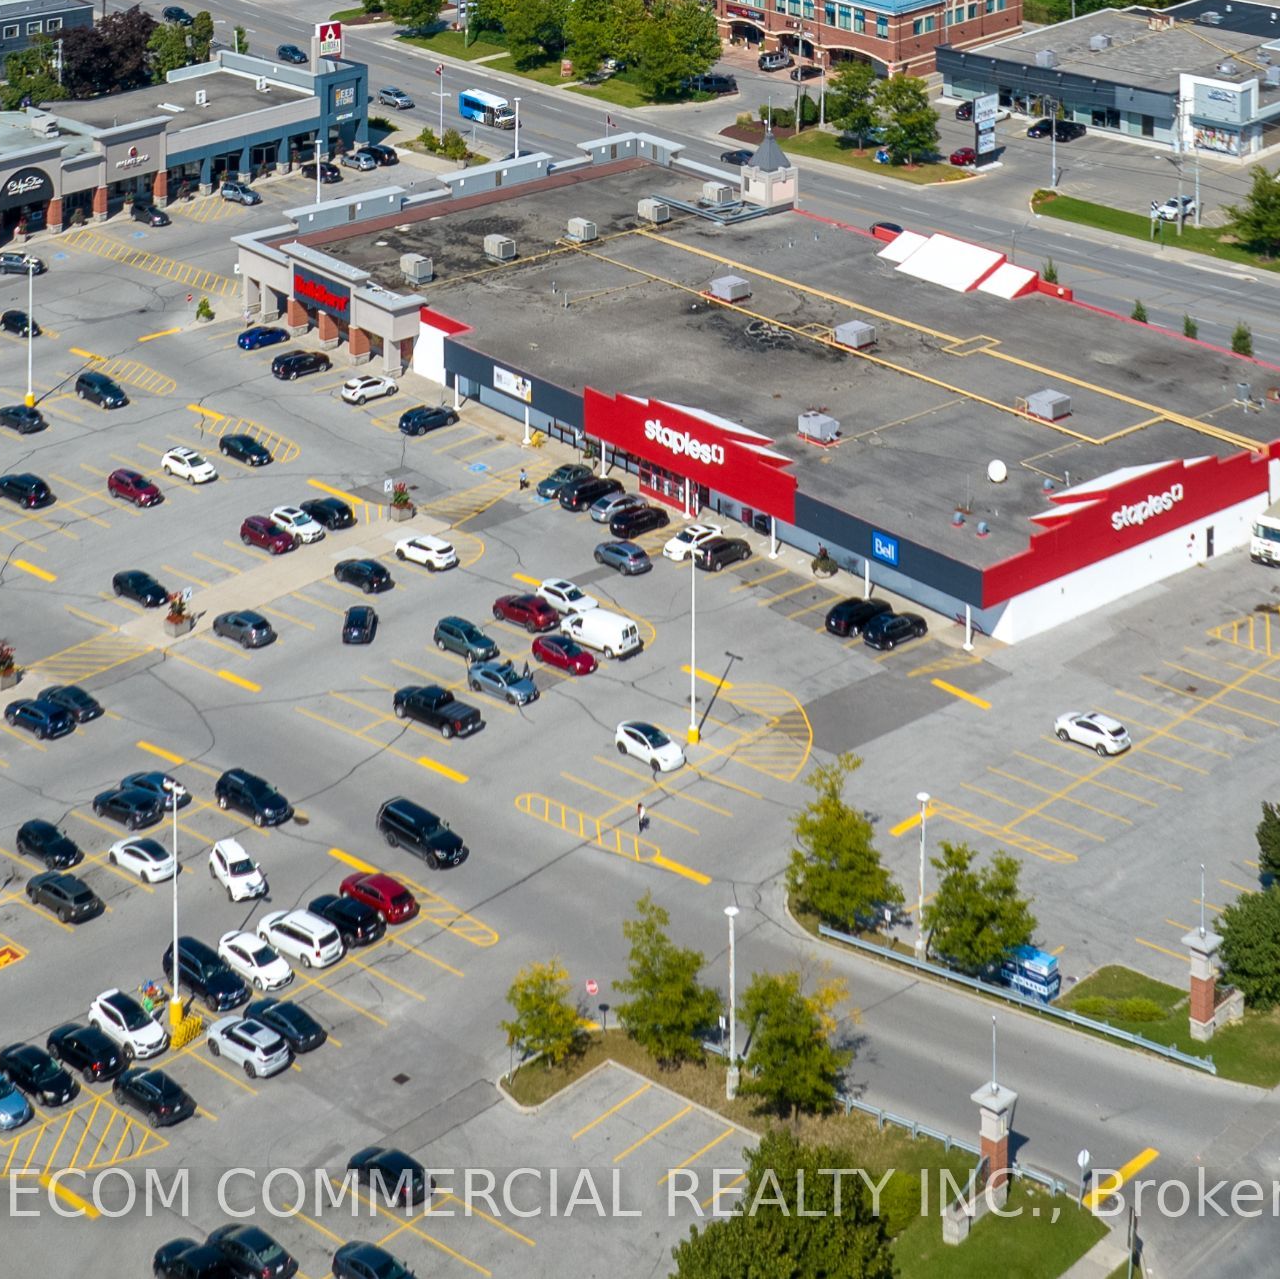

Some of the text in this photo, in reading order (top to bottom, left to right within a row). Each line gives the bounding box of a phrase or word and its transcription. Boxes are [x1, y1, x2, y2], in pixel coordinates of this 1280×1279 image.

[644, 419, 712, 465] staples
[1111, 491, 1174, 531] staples
[875, 537, 895, 561] Bell
